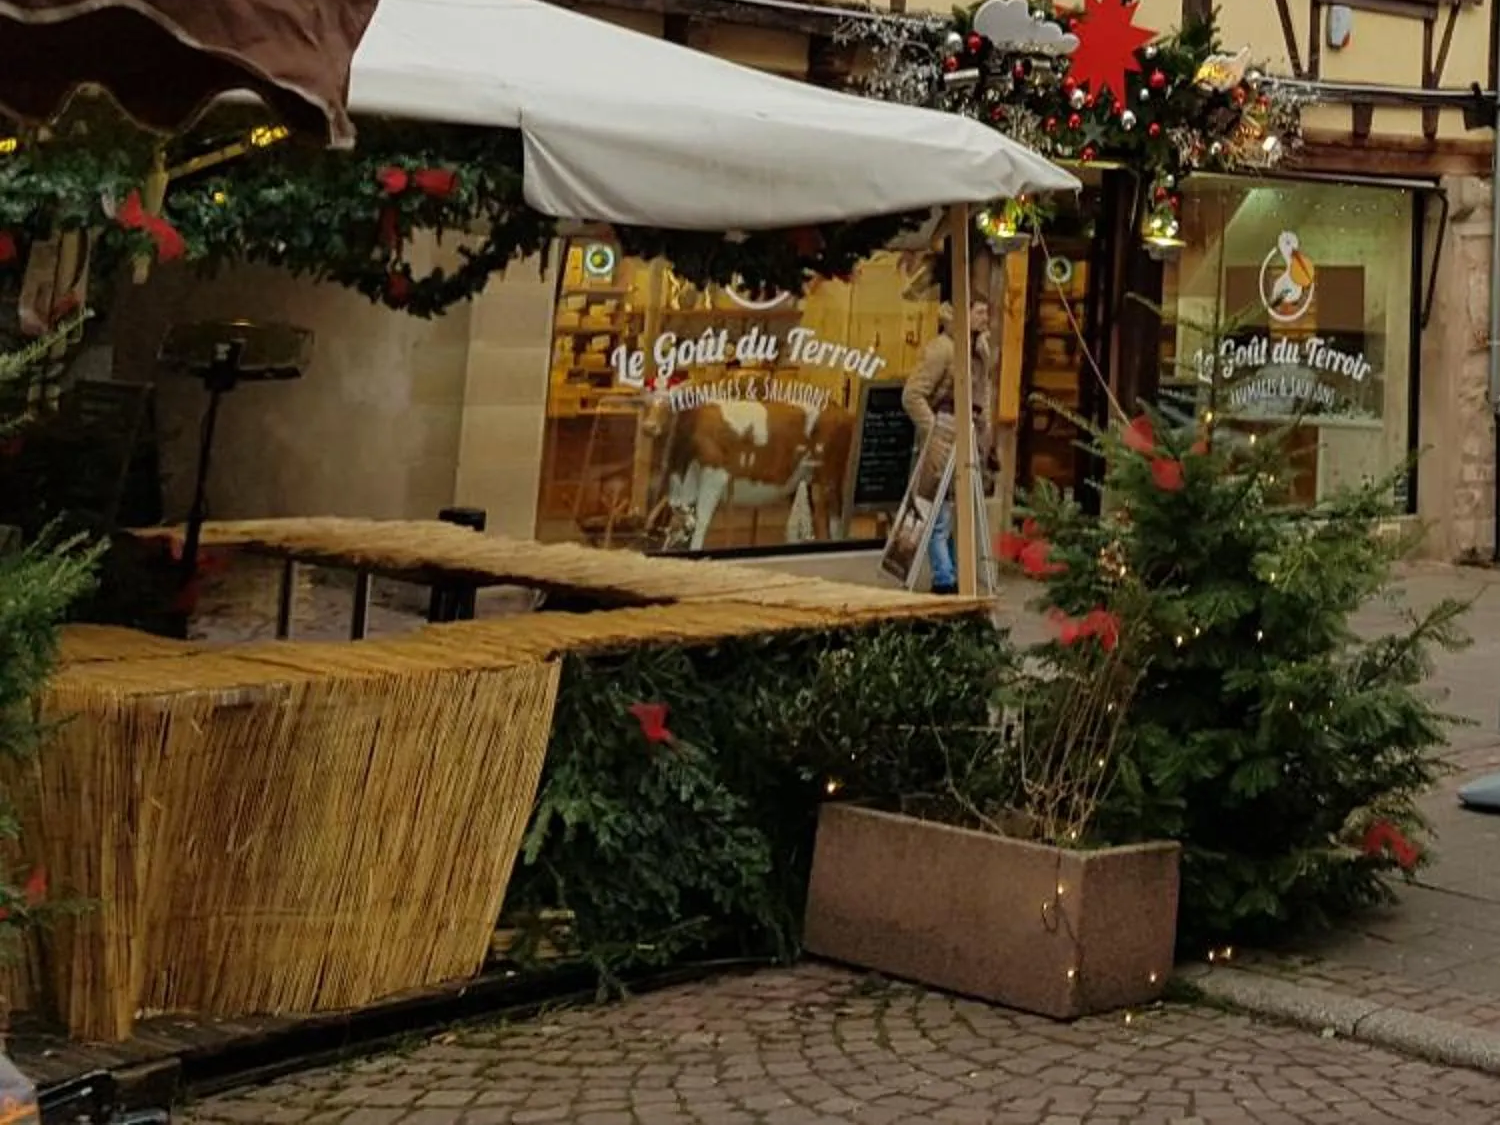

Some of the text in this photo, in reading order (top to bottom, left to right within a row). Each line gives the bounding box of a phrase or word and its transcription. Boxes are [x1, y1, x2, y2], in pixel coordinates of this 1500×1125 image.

[610, 326, 887, 387] Le Goût du Terroir
[1193, 335, 1371, 384] Le Goût du Terroir
[669, 378, 832, 413] FROMAGES & SALAISONS
